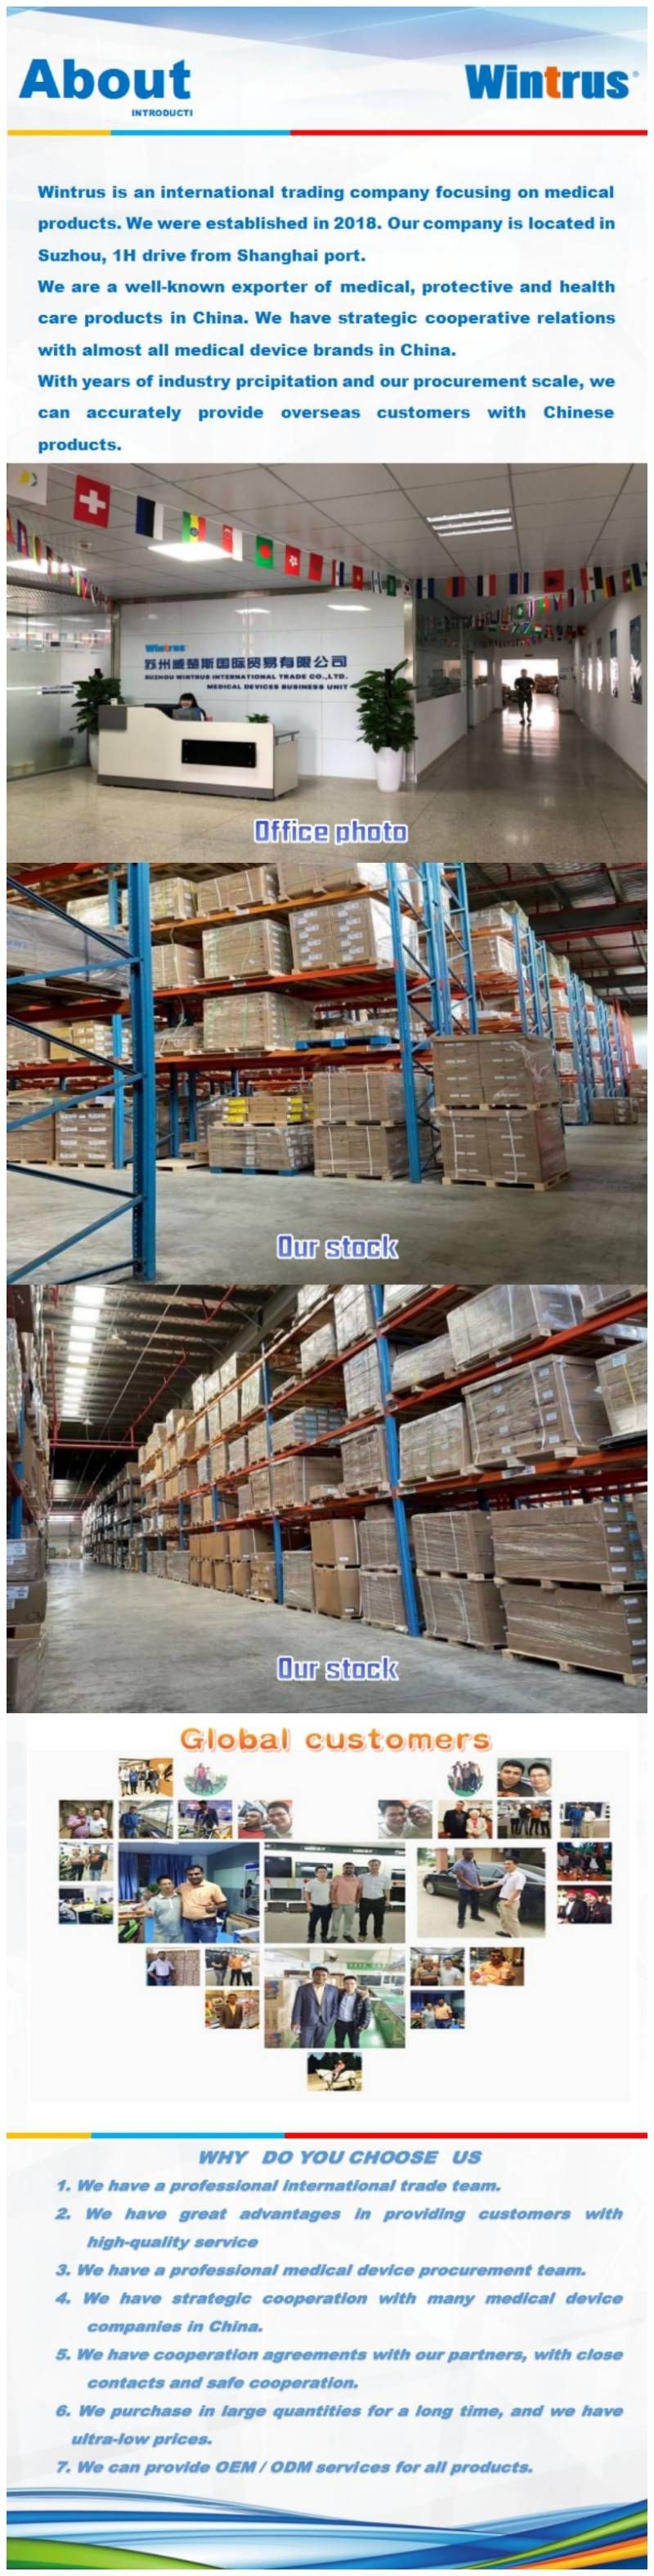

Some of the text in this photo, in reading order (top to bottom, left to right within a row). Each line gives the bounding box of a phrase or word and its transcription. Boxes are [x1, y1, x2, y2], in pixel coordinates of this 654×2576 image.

[19, 59, 190, 99] About
[465, 65, 629, 99] Wintrus
[38, 186, 615, 201] Wintrus is an international trading company focusing on medical
[38, 249, 366, 265] Suzhou, 1H drive from Shanghai port.
[38, 280, 616, 296] We are a well-known exporter of medical, protective and health
[38, 311, 616, 327] care products in China. We have strategic cooperative relations
[38, 343, 457, 357] with almost all medical device brands in China.
[38, 375, 616, 391] With years of industry prcipitation and our procurement scale, we
[38, 406, 616, 422] can accurately provide overseas customers with Chinese
[38, 438, 122, 454] products.
[199, 2151, 482, 2165] WHY DO YOU CHOOSE US
[57, 2179, 499, 2194] 1. We have a professional international trade team.
[55, 2207, 624, 2223] 2. We have great advantages in providing customers with
[56, 2264, 585, 2278] 3. We have a professional medical device procurement team.
[56, 2292, 624, 2307] 4. We have strategic cooperation with many medical device
[87, 2320, 262, 2334] companies in China.
[56, 2349, 624, 2363] 5. We have cooperation agreements with our partners, with close
[56, 2404, 624, 2420] 6. We purchase in large quantities for a long time, and we have
[71, 2434, 210, 2447] ultra-low prices.
